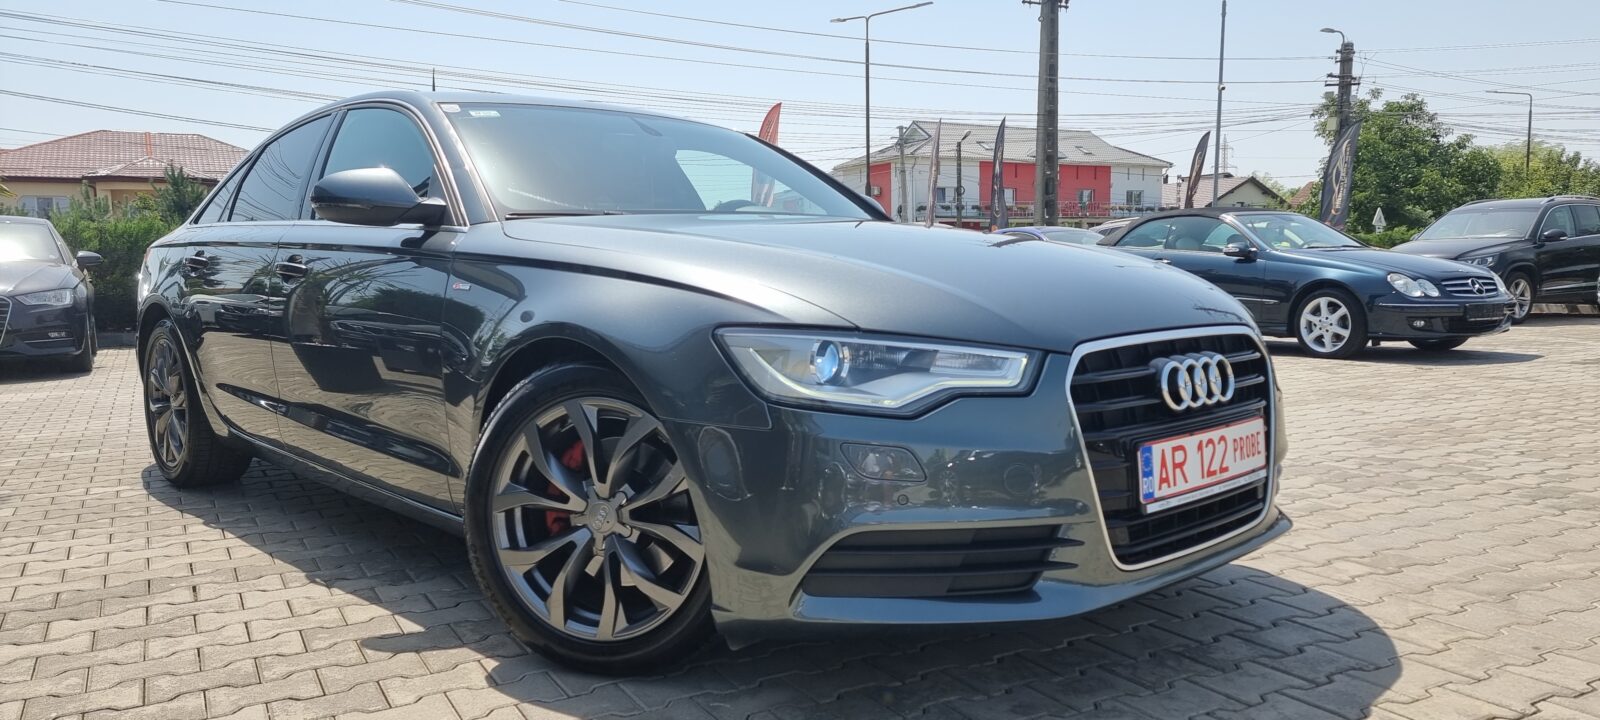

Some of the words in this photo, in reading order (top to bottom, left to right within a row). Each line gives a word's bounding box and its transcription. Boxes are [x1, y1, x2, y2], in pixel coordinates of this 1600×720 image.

[1158, 445, 1188, 490] AR
[1197, 435, 1229, 480] 122
[1233, 432, 1262, 463] PROBE
[1143, 476, 1153, 494] RO
